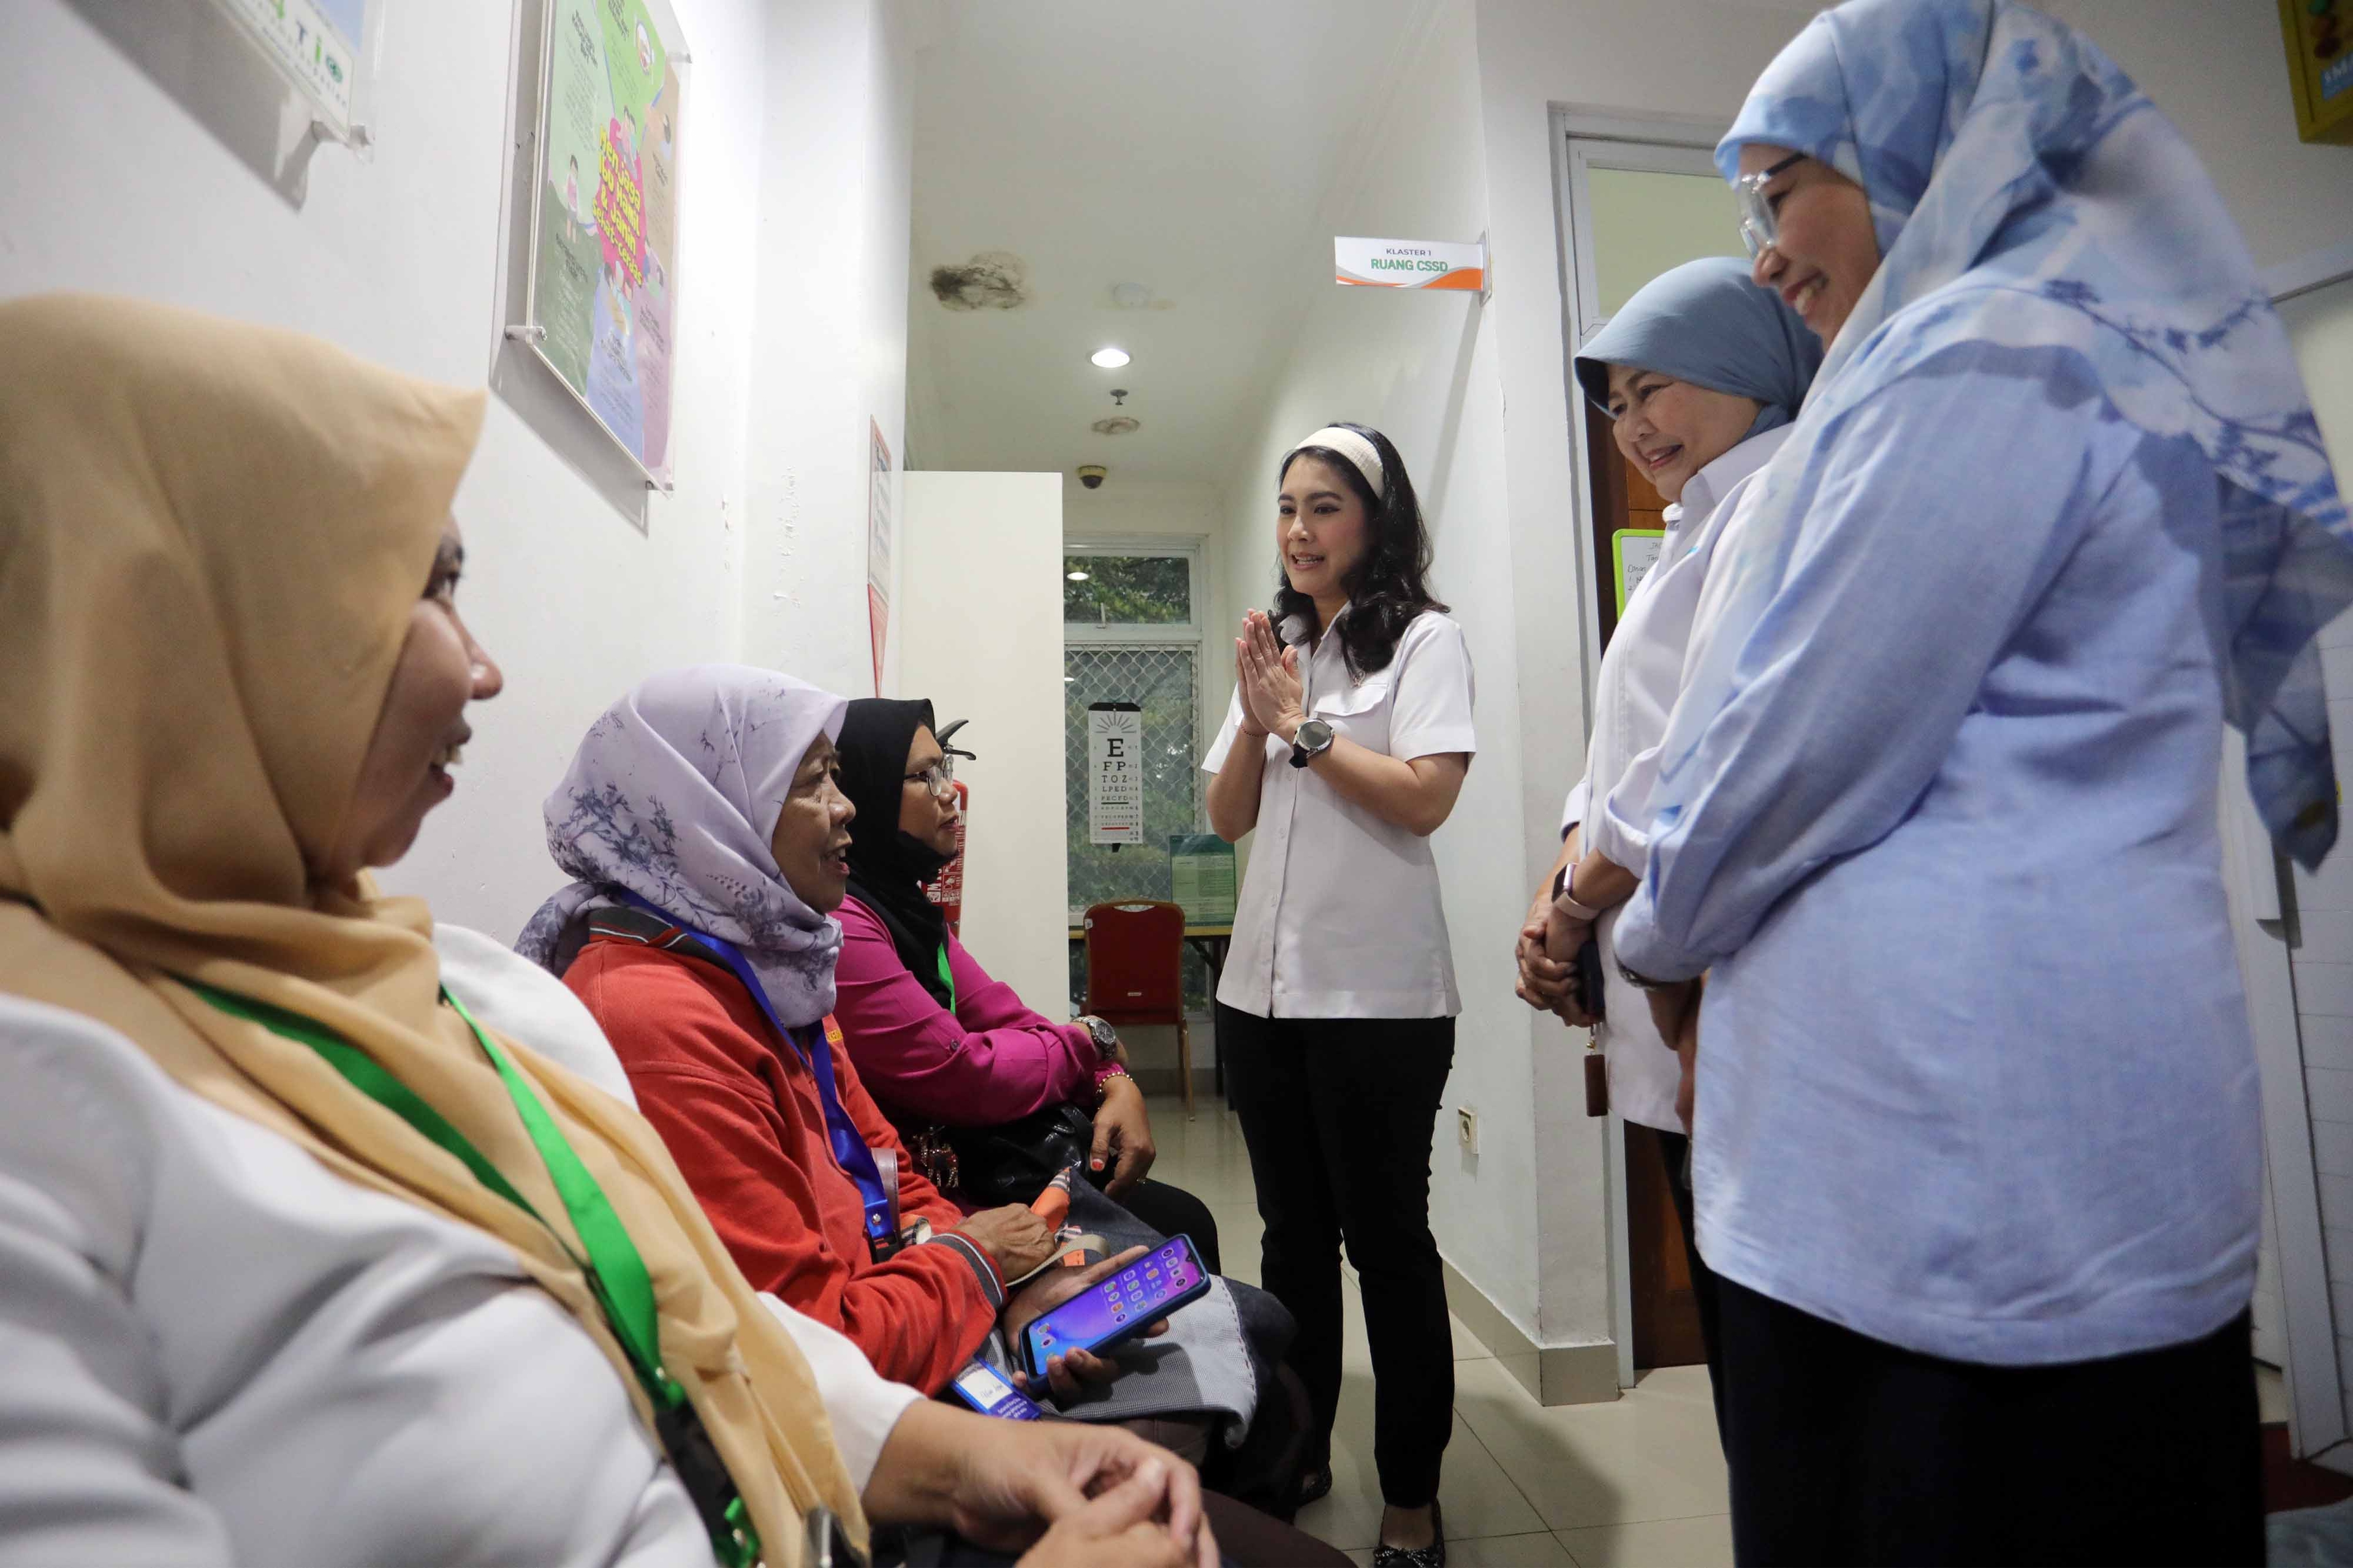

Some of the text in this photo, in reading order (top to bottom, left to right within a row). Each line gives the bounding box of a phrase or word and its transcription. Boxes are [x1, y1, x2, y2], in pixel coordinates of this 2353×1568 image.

[599, 124, 641, 213] Menjaga
[601, 184, 637, 257] & Janin
[616, 182, 641, 238] Hamil
[1370, 259, 1449, 273] RUANG CSSD
[1107, 738, 1124, 757] E
